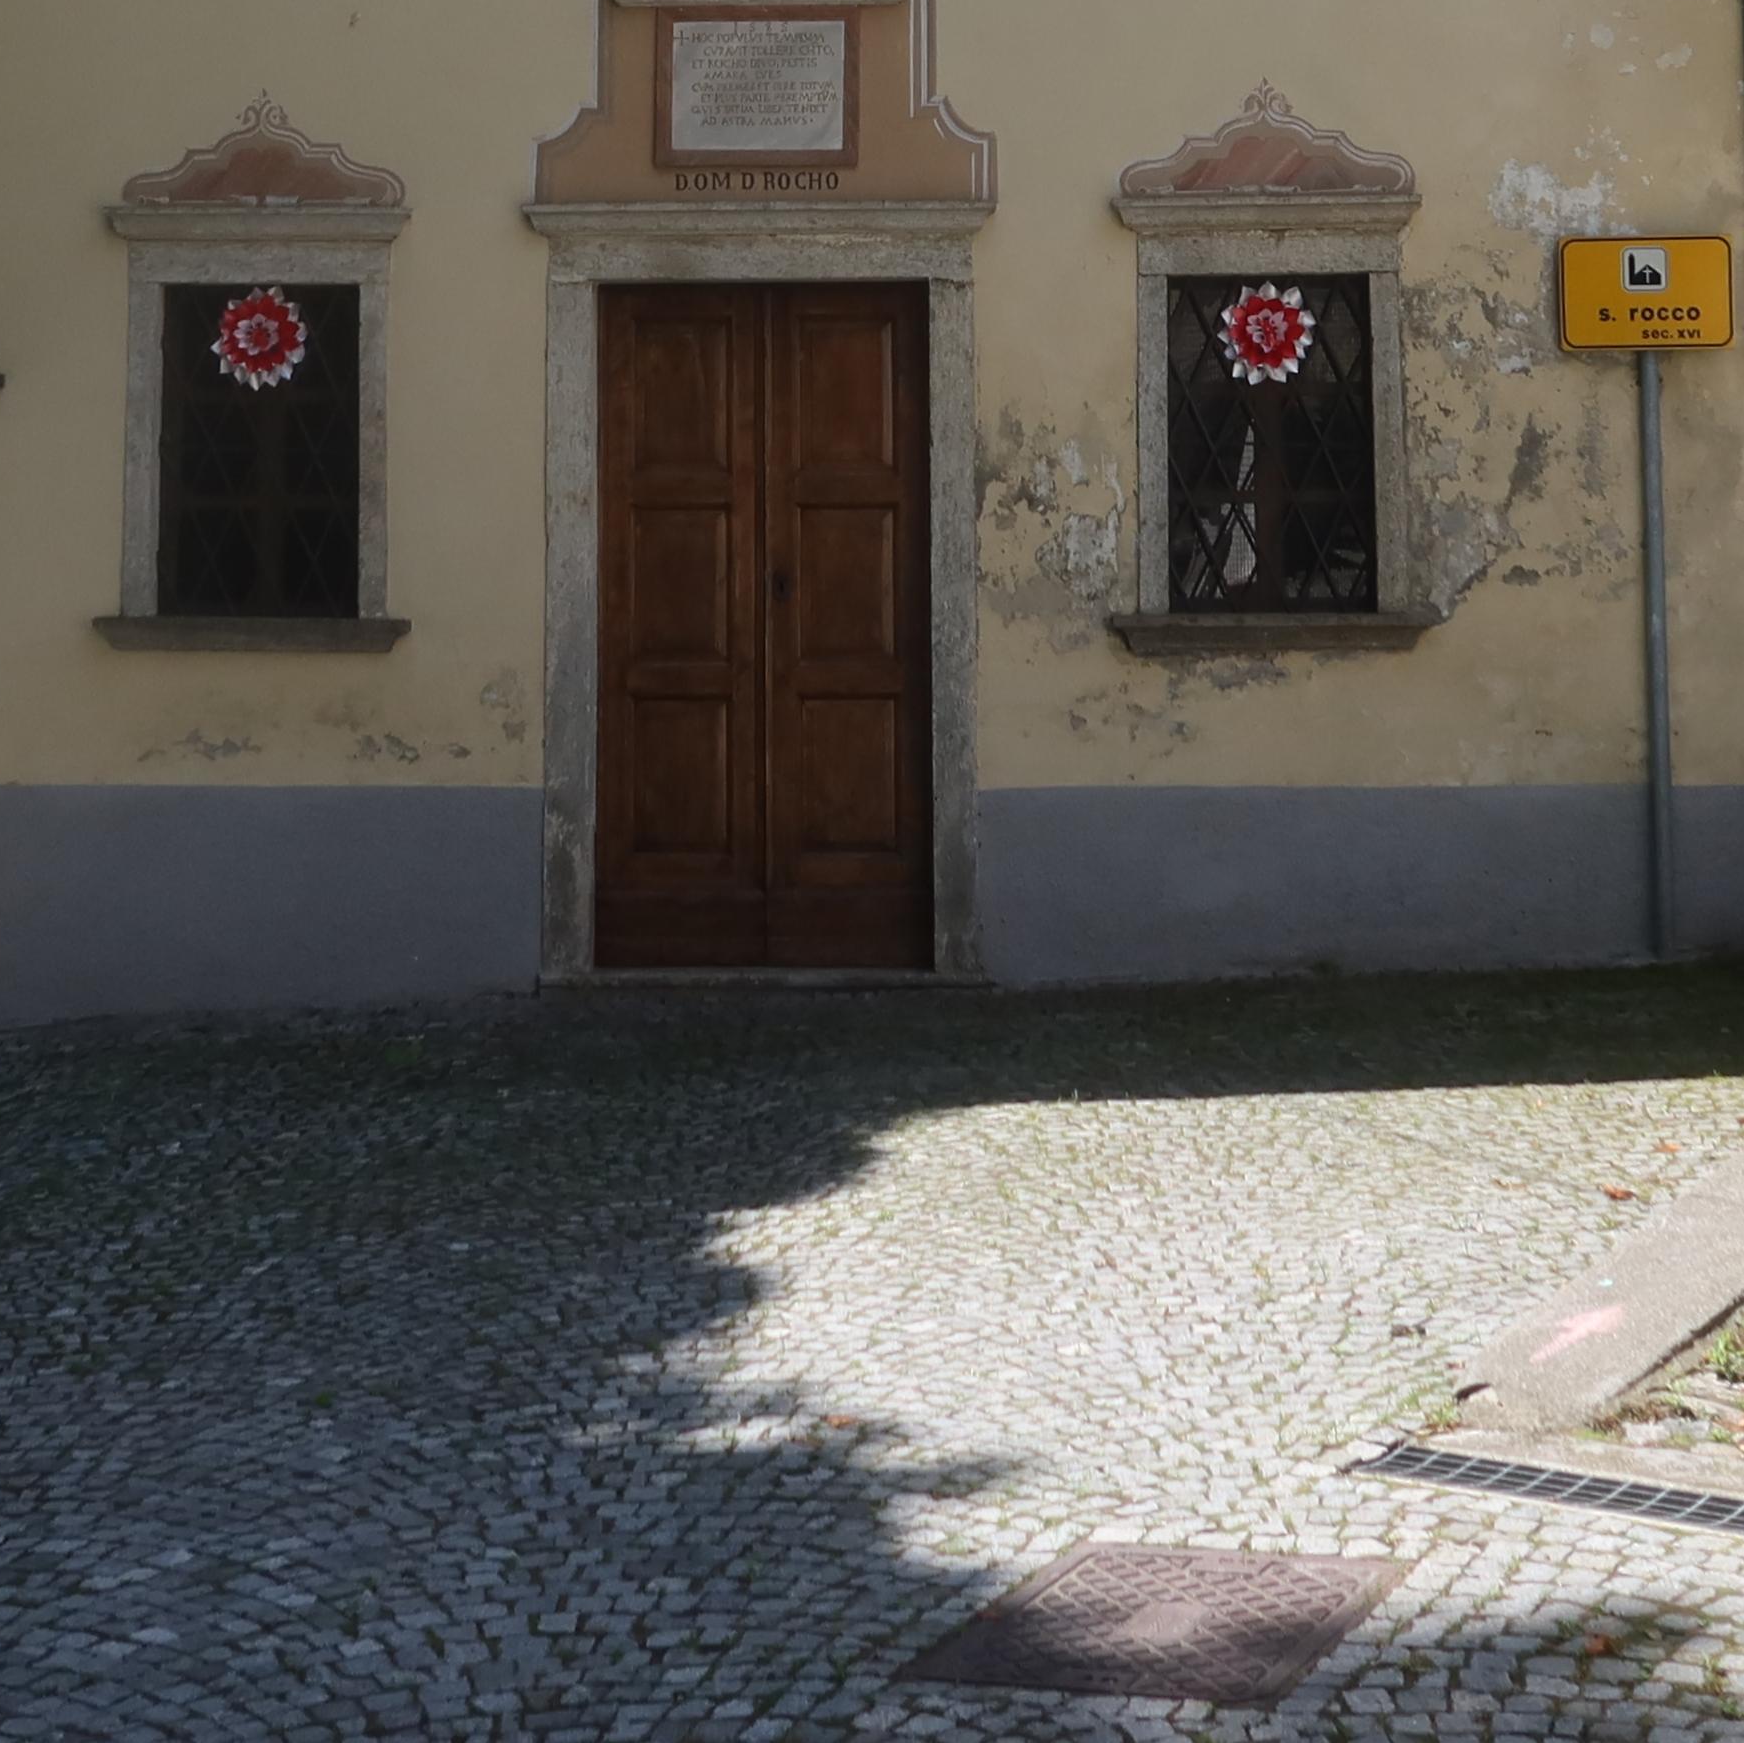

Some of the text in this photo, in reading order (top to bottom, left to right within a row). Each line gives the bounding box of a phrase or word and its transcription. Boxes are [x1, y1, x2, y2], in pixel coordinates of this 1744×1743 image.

[691, 58, 704, 70] ET
[701, 116, 717, 127] AD
[741, 172, 756, 191] D
[764, 171, 839, 191] ROCHO
[1629, 306, 1702, 322] rocco
[1642, 328, 1674, 340] sec.
